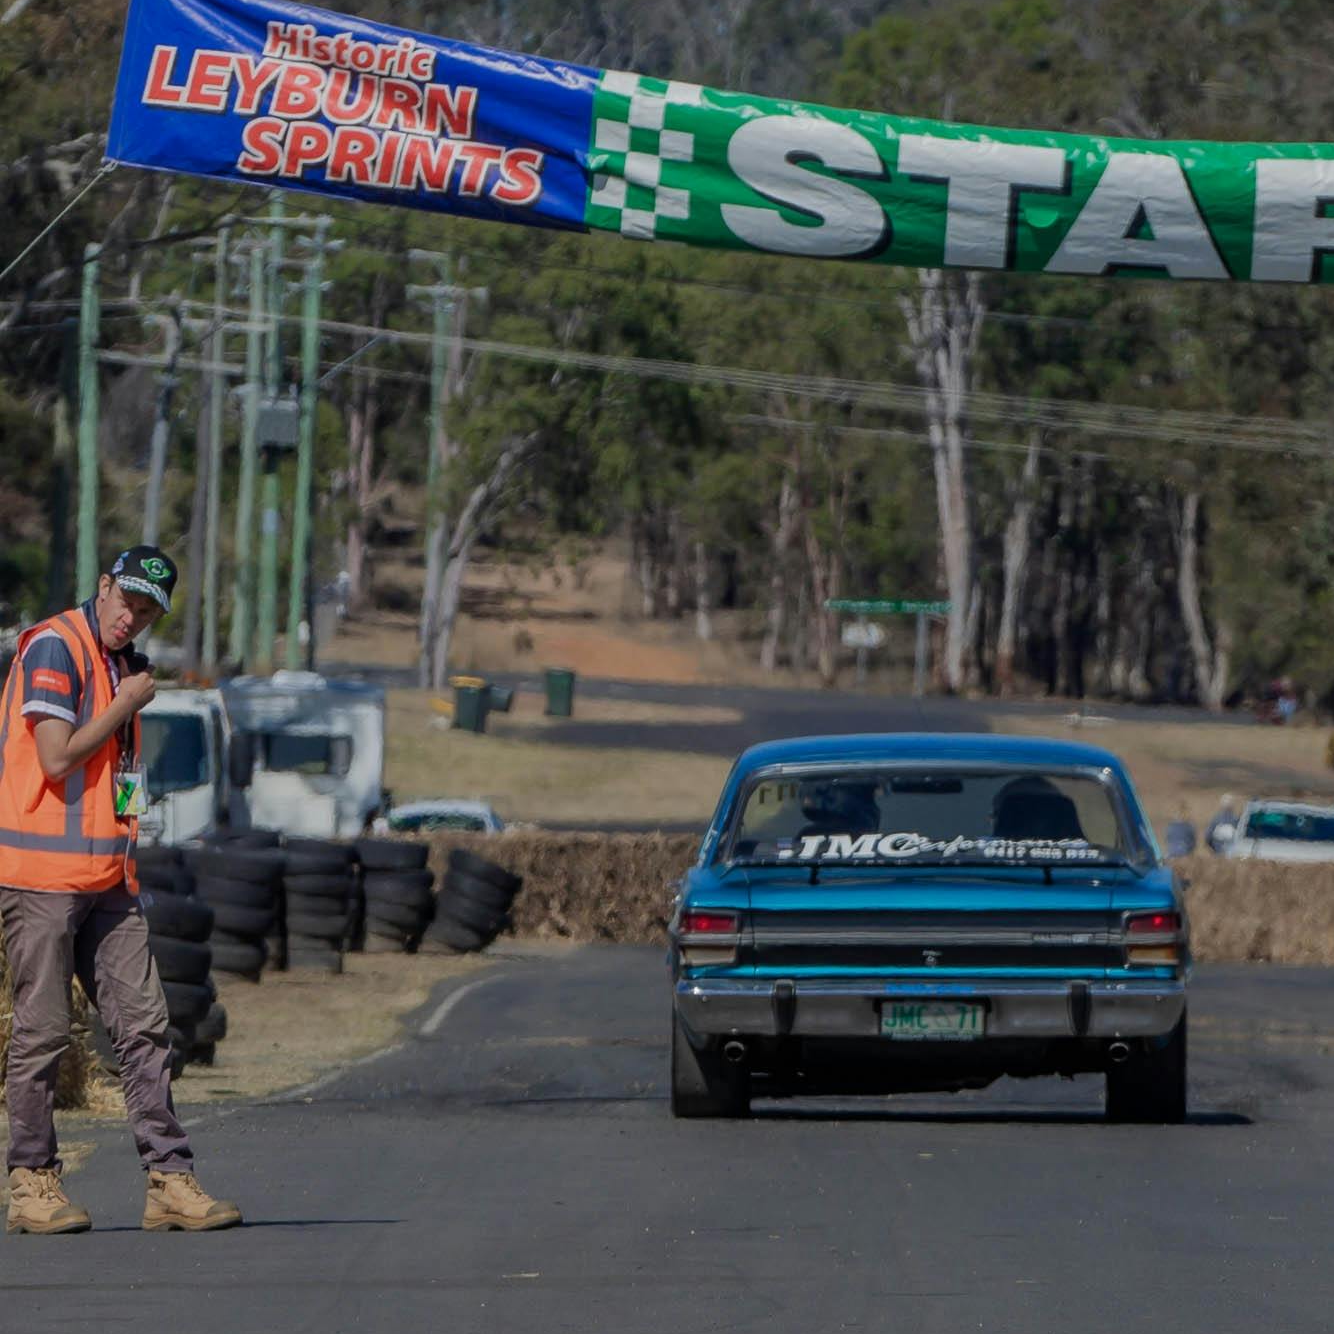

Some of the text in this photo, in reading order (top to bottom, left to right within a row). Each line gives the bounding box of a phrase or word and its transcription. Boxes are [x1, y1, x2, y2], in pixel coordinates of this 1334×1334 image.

[262, 21, 436, 81] Historic
[142, 45, 478, 139] LEYBURN
[237, 118, 545, 206] SPRINTS
[797, 832, 922, 859] JMC
[884, 1003, 929, 1029] JMC
